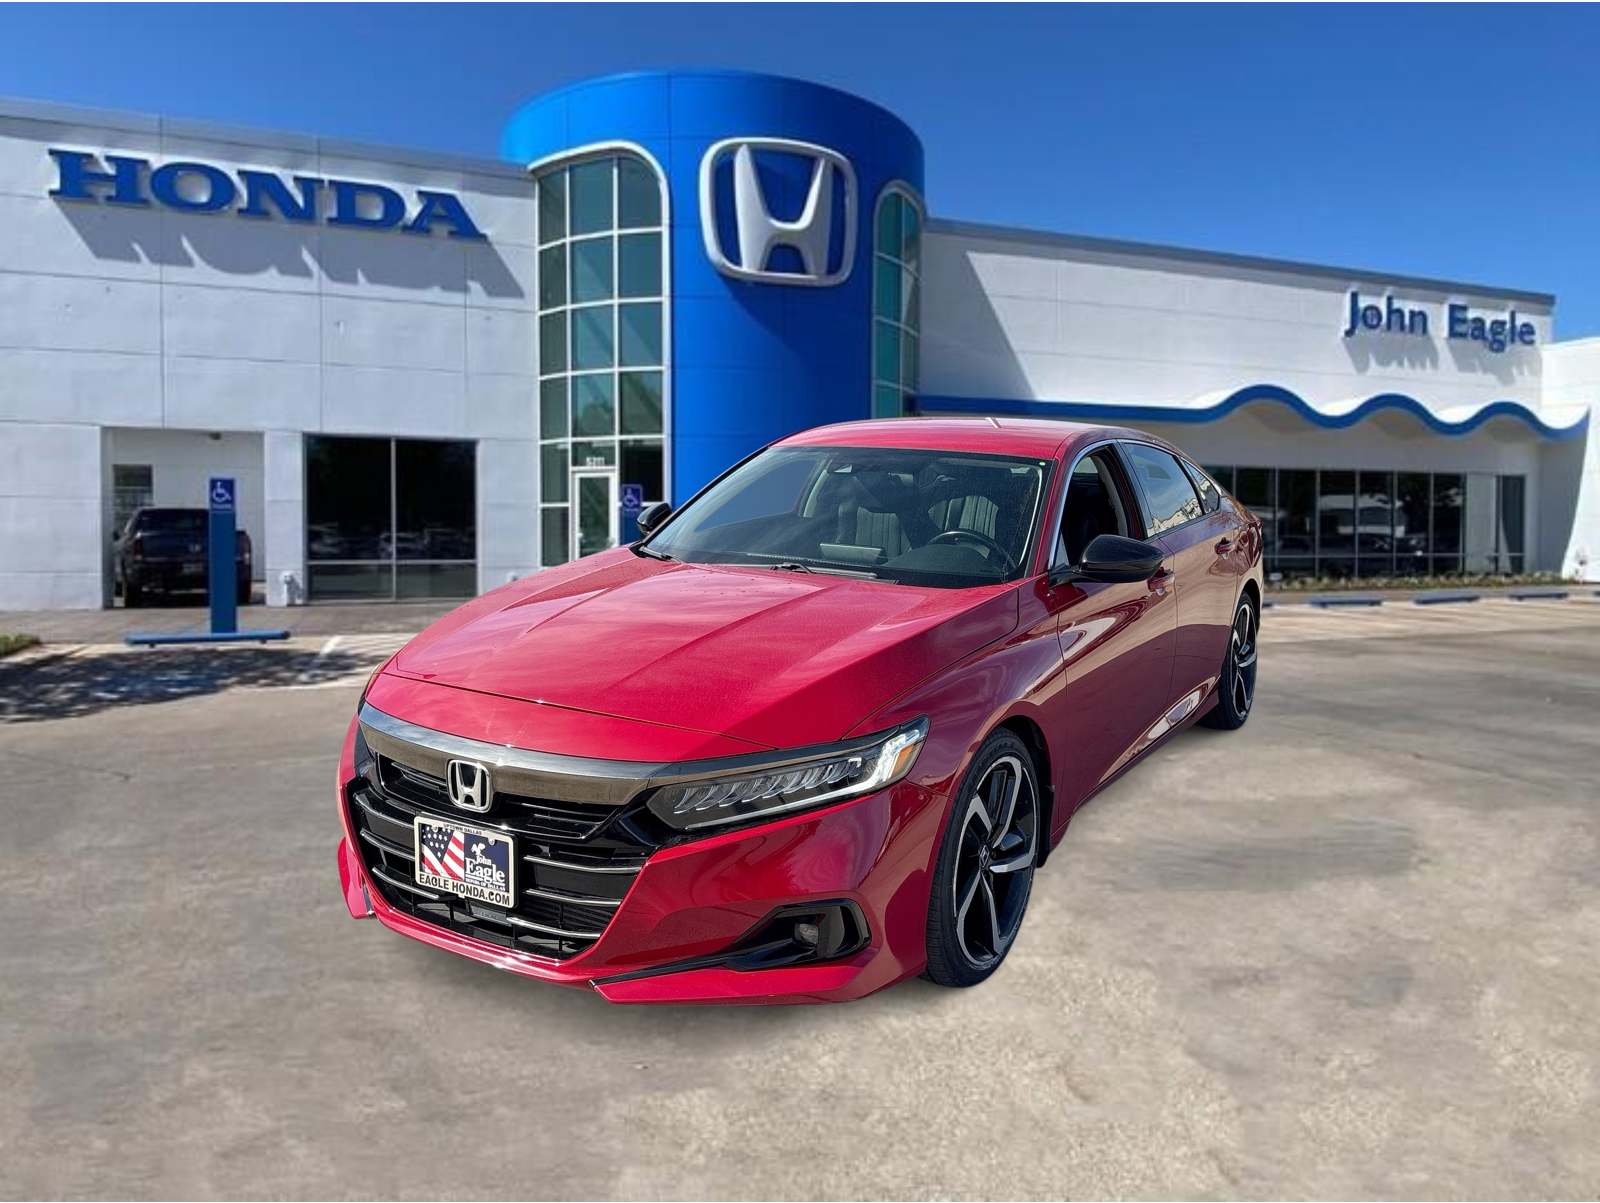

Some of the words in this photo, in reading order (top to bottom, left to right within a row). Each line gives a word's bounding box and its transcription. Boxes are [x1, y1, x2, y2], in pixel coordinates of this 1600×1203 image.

[48, 149, 488, 241] HONDA
[1344, 291, 1428, 337] John
[1449, 304, 1536, 353] Eagle
[465, 857, 505, 884] Eagle
[476, 854, 492, 866] John
[420, 873, 450, 892] EAGLE
[452, 881, 510, 906] HONDA.COM
